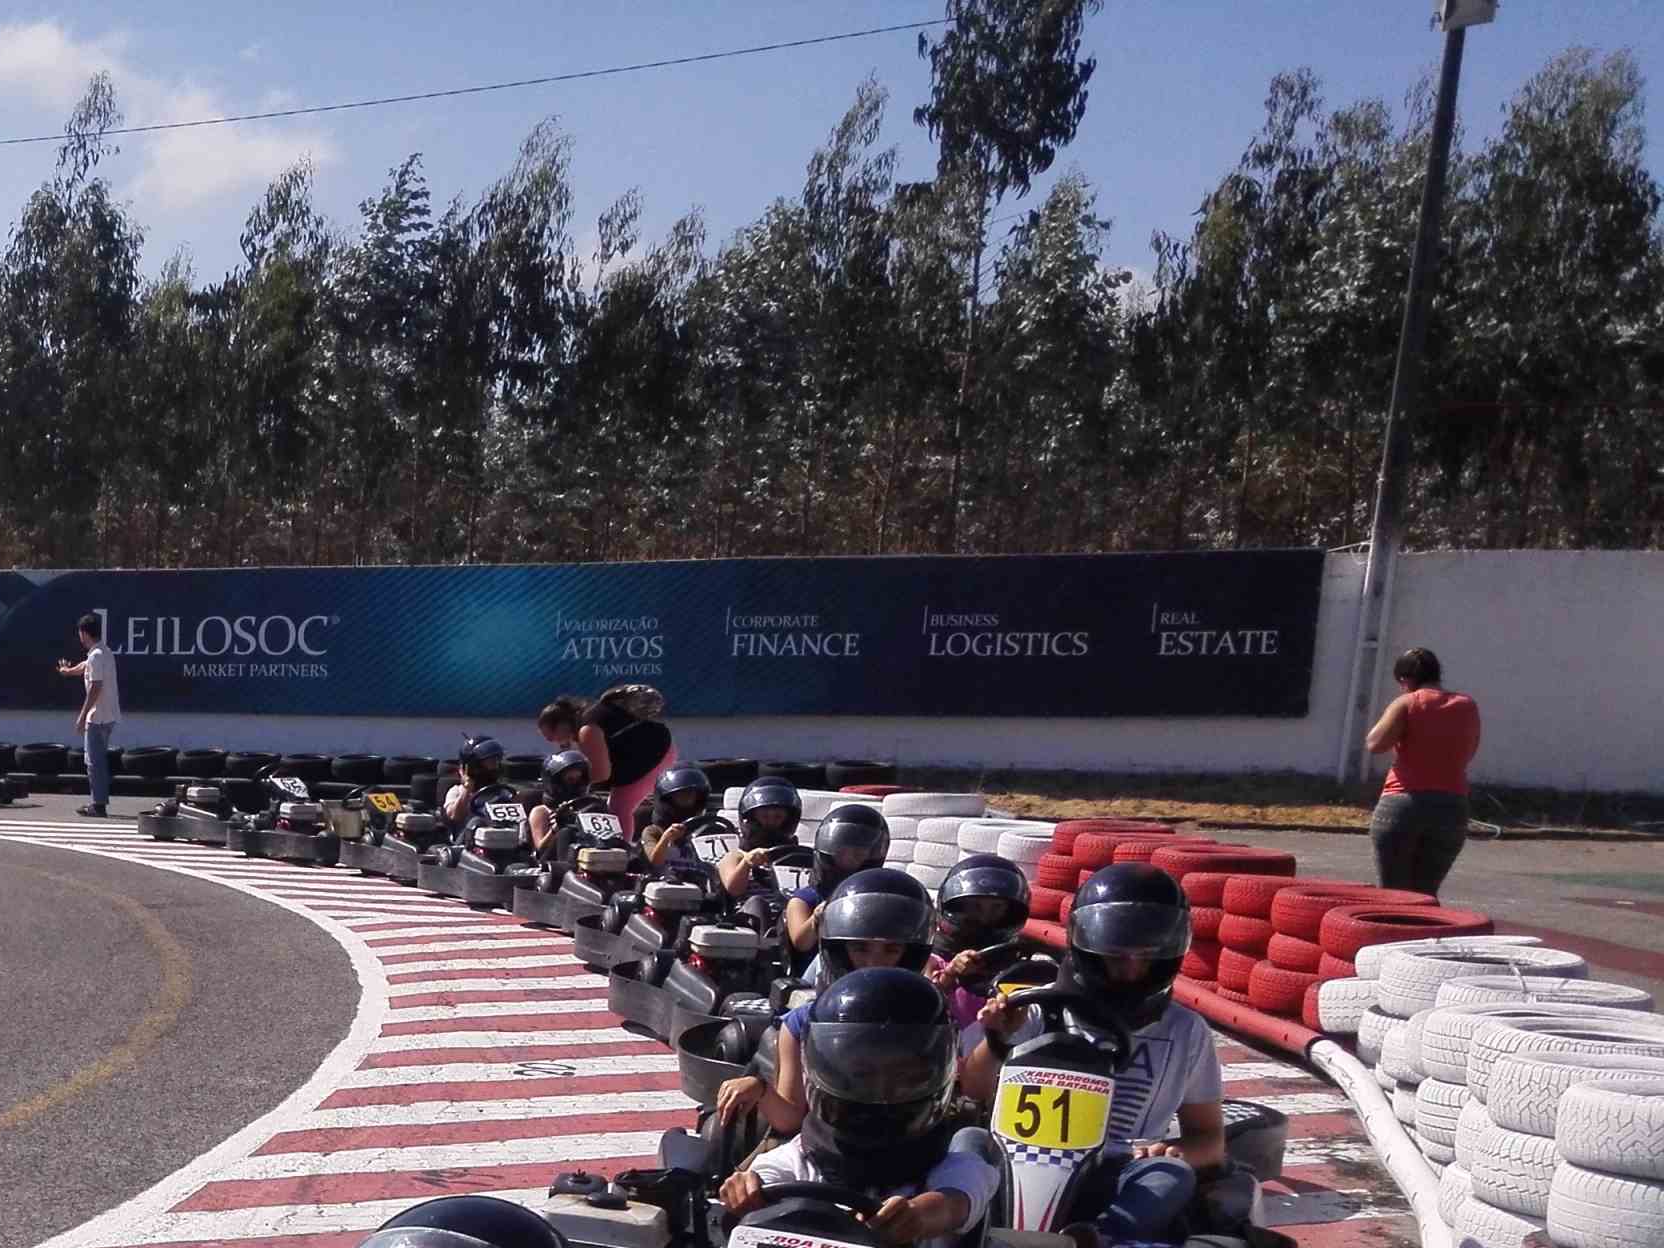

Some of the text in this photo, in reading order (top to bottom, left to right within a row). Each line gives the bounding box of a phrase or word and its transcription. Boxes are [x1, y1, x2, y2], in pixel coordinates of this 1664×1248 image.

[733, 615, 820, 629] CORPORATE
[930, 614, 1000, 626] BUSINESS
[1159, 612, 1198, 625] REAL
[93, 608, 329, 656] LEILOSOC
[563, 635, 664, 659] ATIVOS
[732, 633, 860, 656] FINANCE
[929, 631, 1090, 657] LOGISTICS
[1158, 630, 1279, 656] ESTATE
[183, 663, 329, 679] MARKET PARTNERS
[492, 806, 520, 818] 68
[590, 817, 613, 832] 63
[1014, 1085, 1072, 1143] 51
